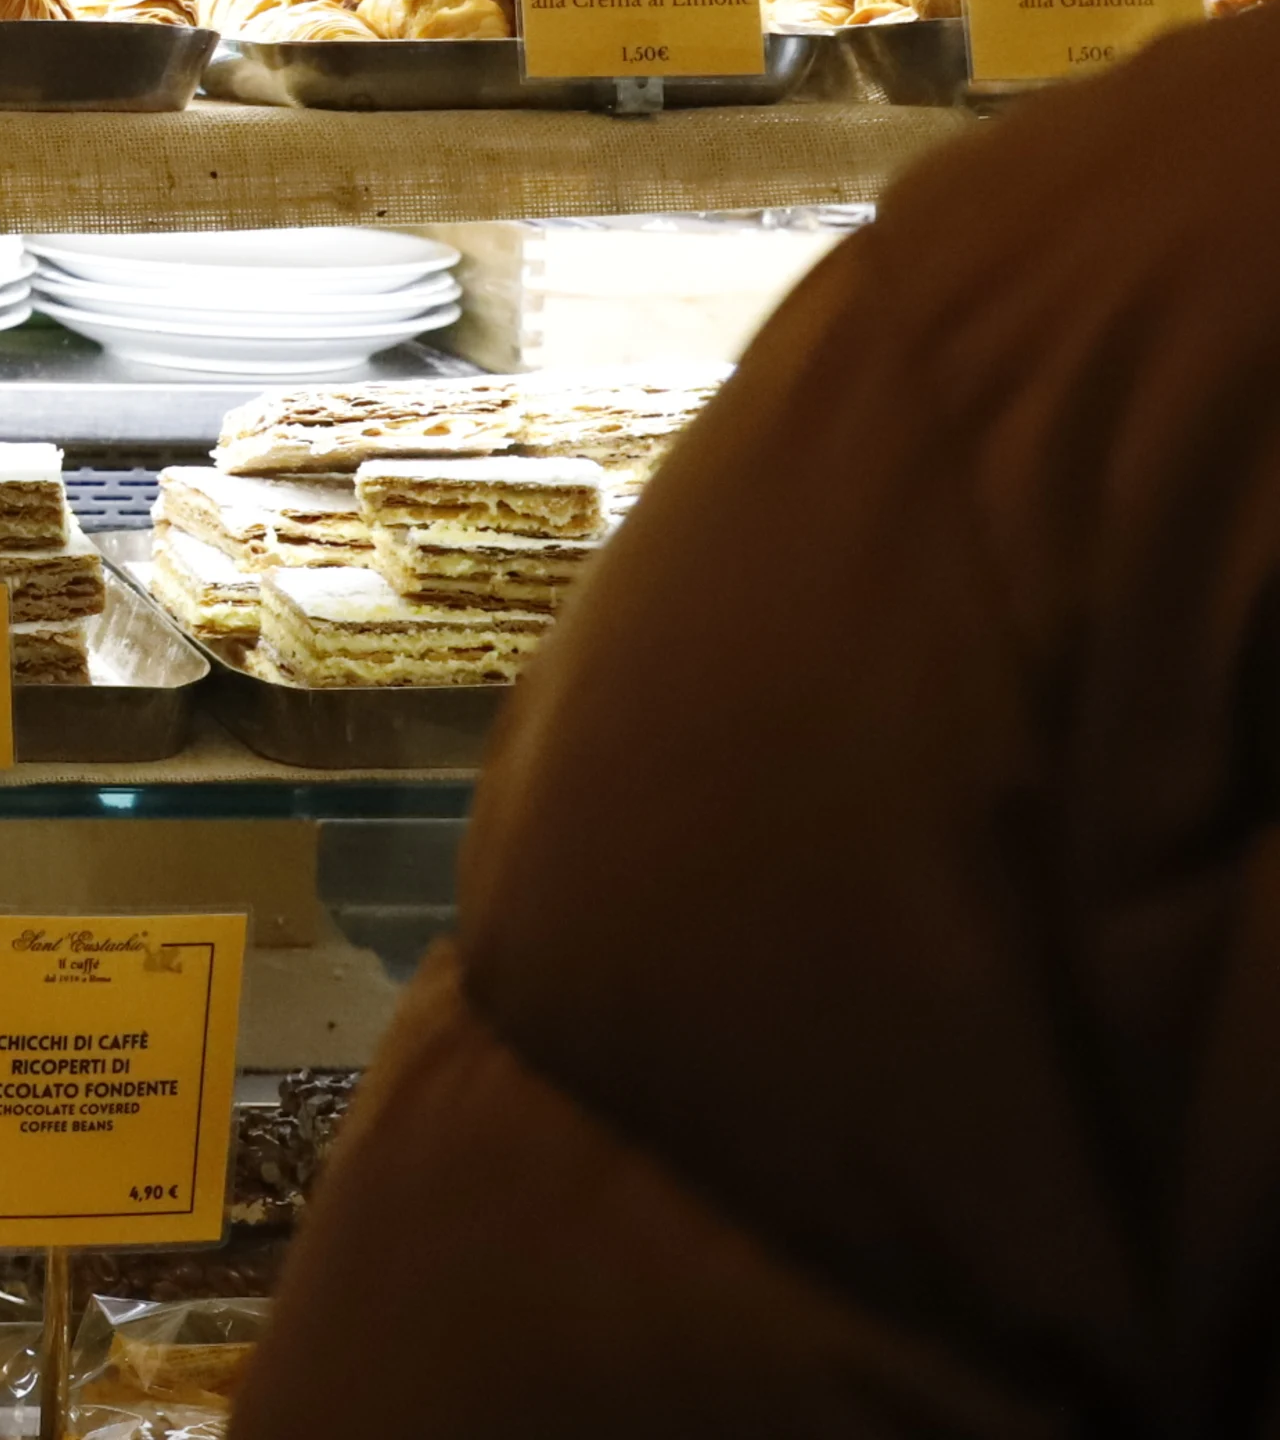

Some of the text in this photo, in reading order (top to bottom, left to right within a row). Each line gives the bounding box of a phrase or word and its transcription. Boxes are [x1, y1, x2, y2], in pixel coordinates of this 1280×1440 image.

[621, 46, 669, 64] 1,50€
[72, 1034, 94, 1051] DI
[97, 1029, 149, 1050] CAFFÈ
[10, 1057, 130, 1076] RICOPERTI DI
[84, 1080, 179, 1098] FONDENTE
[79, 1102, 141, 1116] COVERED
[19, 1120, 114, 1134] COFFEE BEANS
[128, 1184, 179, 1203] 4,90 €
